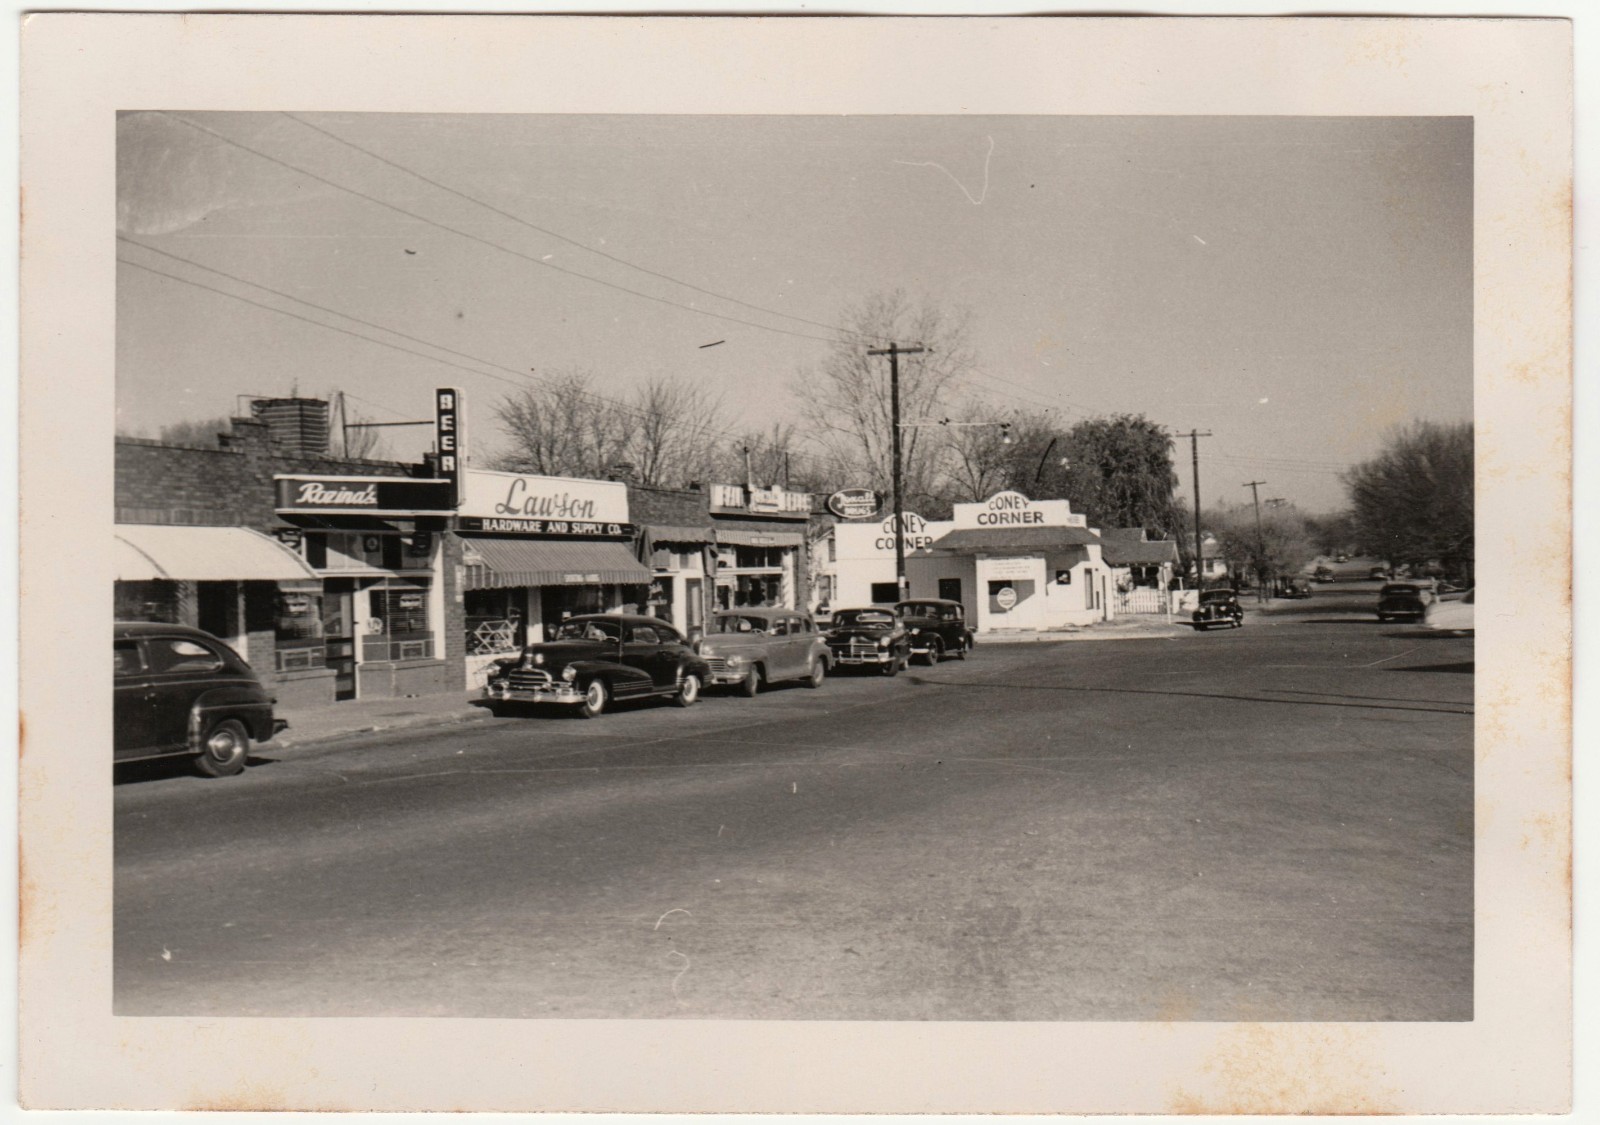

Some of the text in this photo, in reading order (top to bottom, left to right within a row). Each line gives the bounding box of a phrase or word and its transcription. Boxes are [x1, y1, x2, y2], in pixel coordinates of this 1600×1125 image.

[440, 394, 455, 472] BEER
[495, 478, 596, 519] Lawson
[989, 495, 1030, 511] CONEY
[977, 511, 1045, 525] CORNER
[482, 518, 622, 535] HARDWARE AND SUPPLY CO.
[875, 536, 933, 550] CONER
